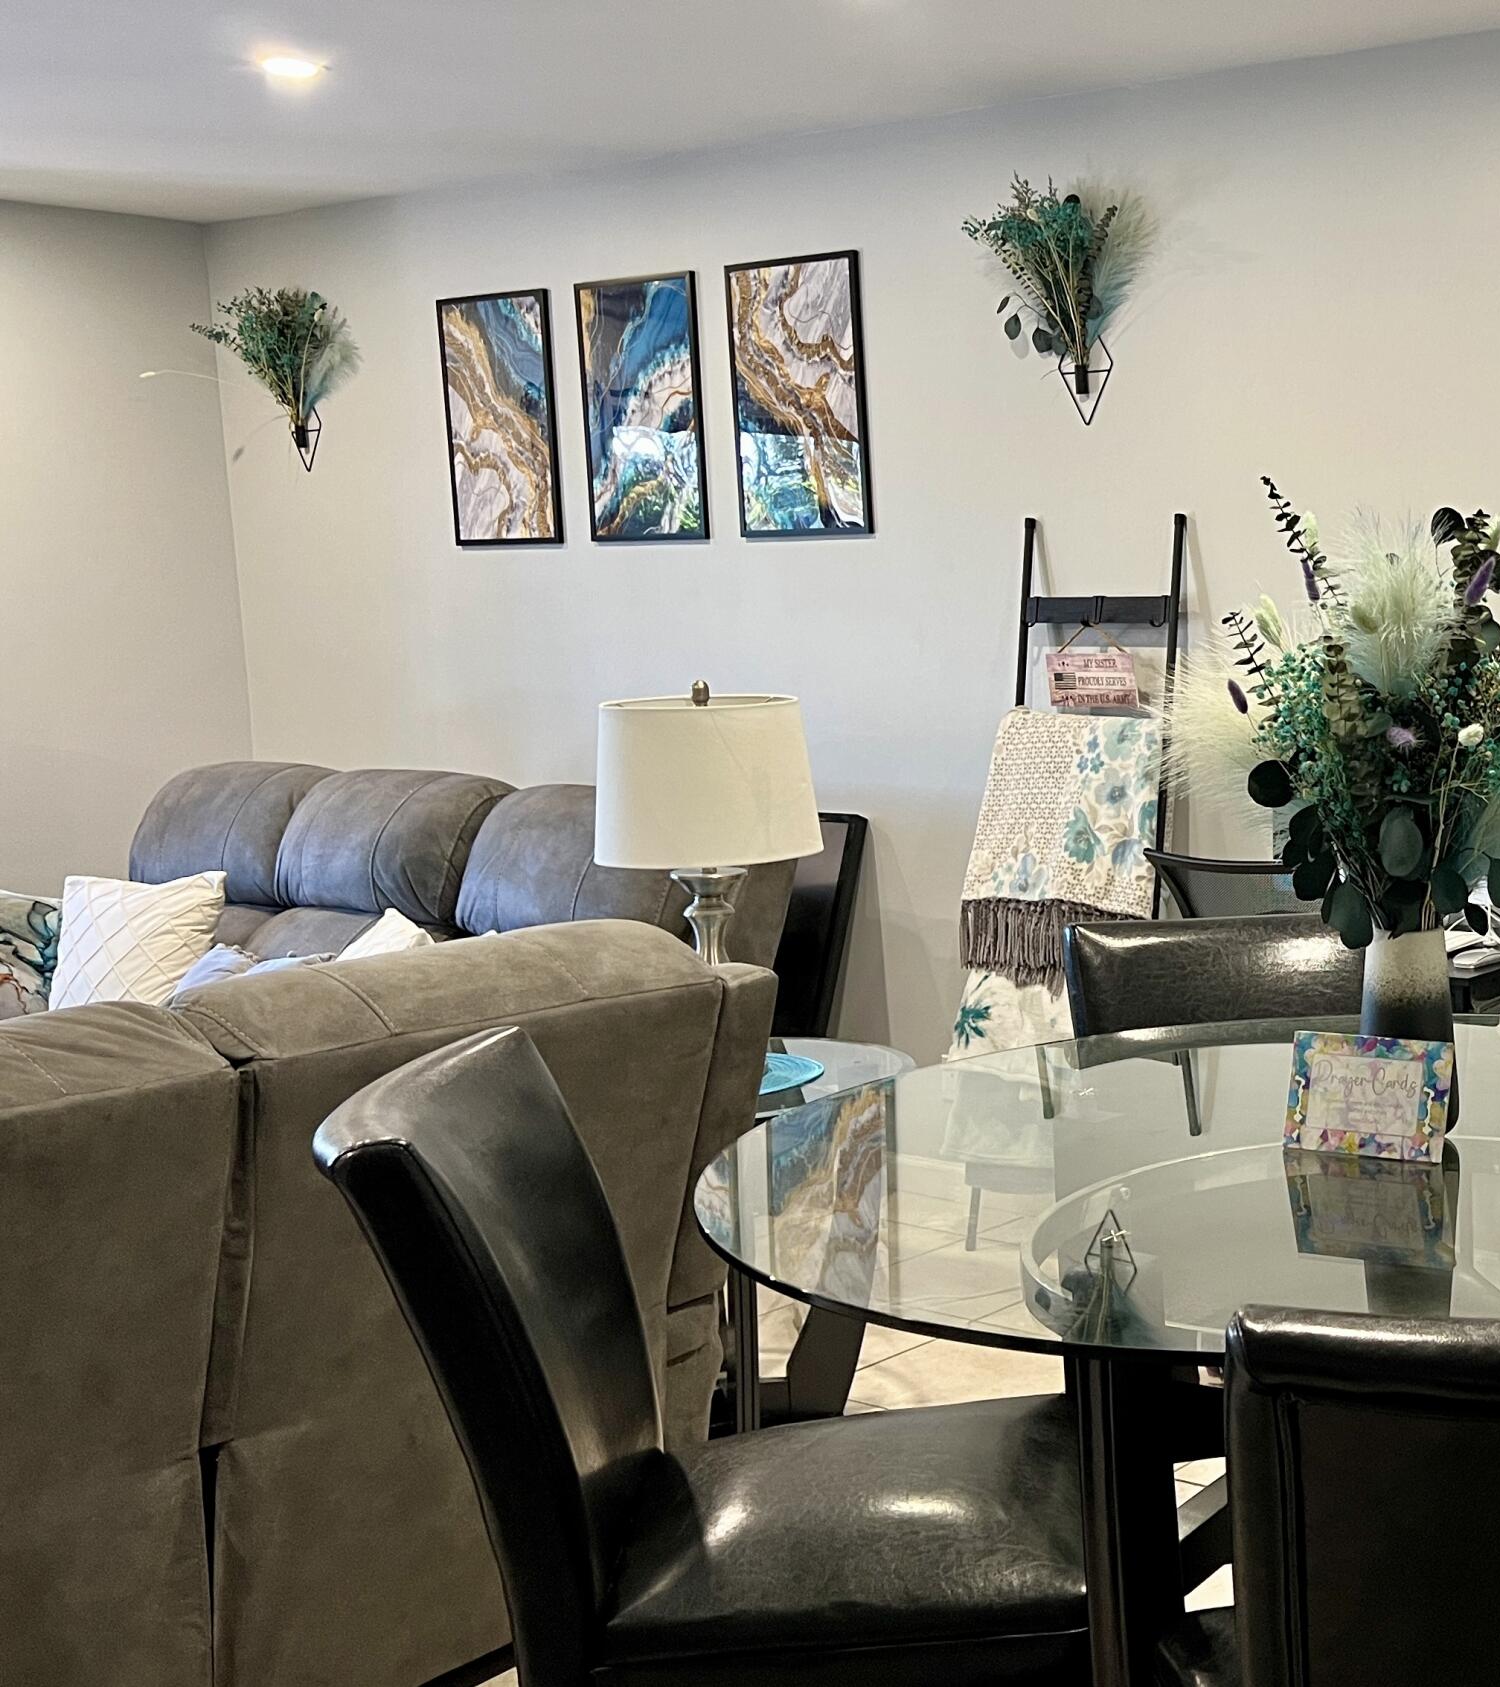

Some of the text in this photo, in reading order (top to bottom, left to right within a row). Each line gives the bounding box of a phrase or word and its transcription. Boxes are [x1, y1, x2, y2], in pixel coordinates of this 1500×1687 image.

[1083, 659, 1117, 668] MY SISTER
[1078, 676, 1127, 686] PROUDLY SERVES
[1077, 694, 1086, 703] IN
[1086, 694, 1099, 703] THE
[1113, 694, 1131, 704] ARMY
[1314, 1059, 1419, 1097] Prayer Cards
